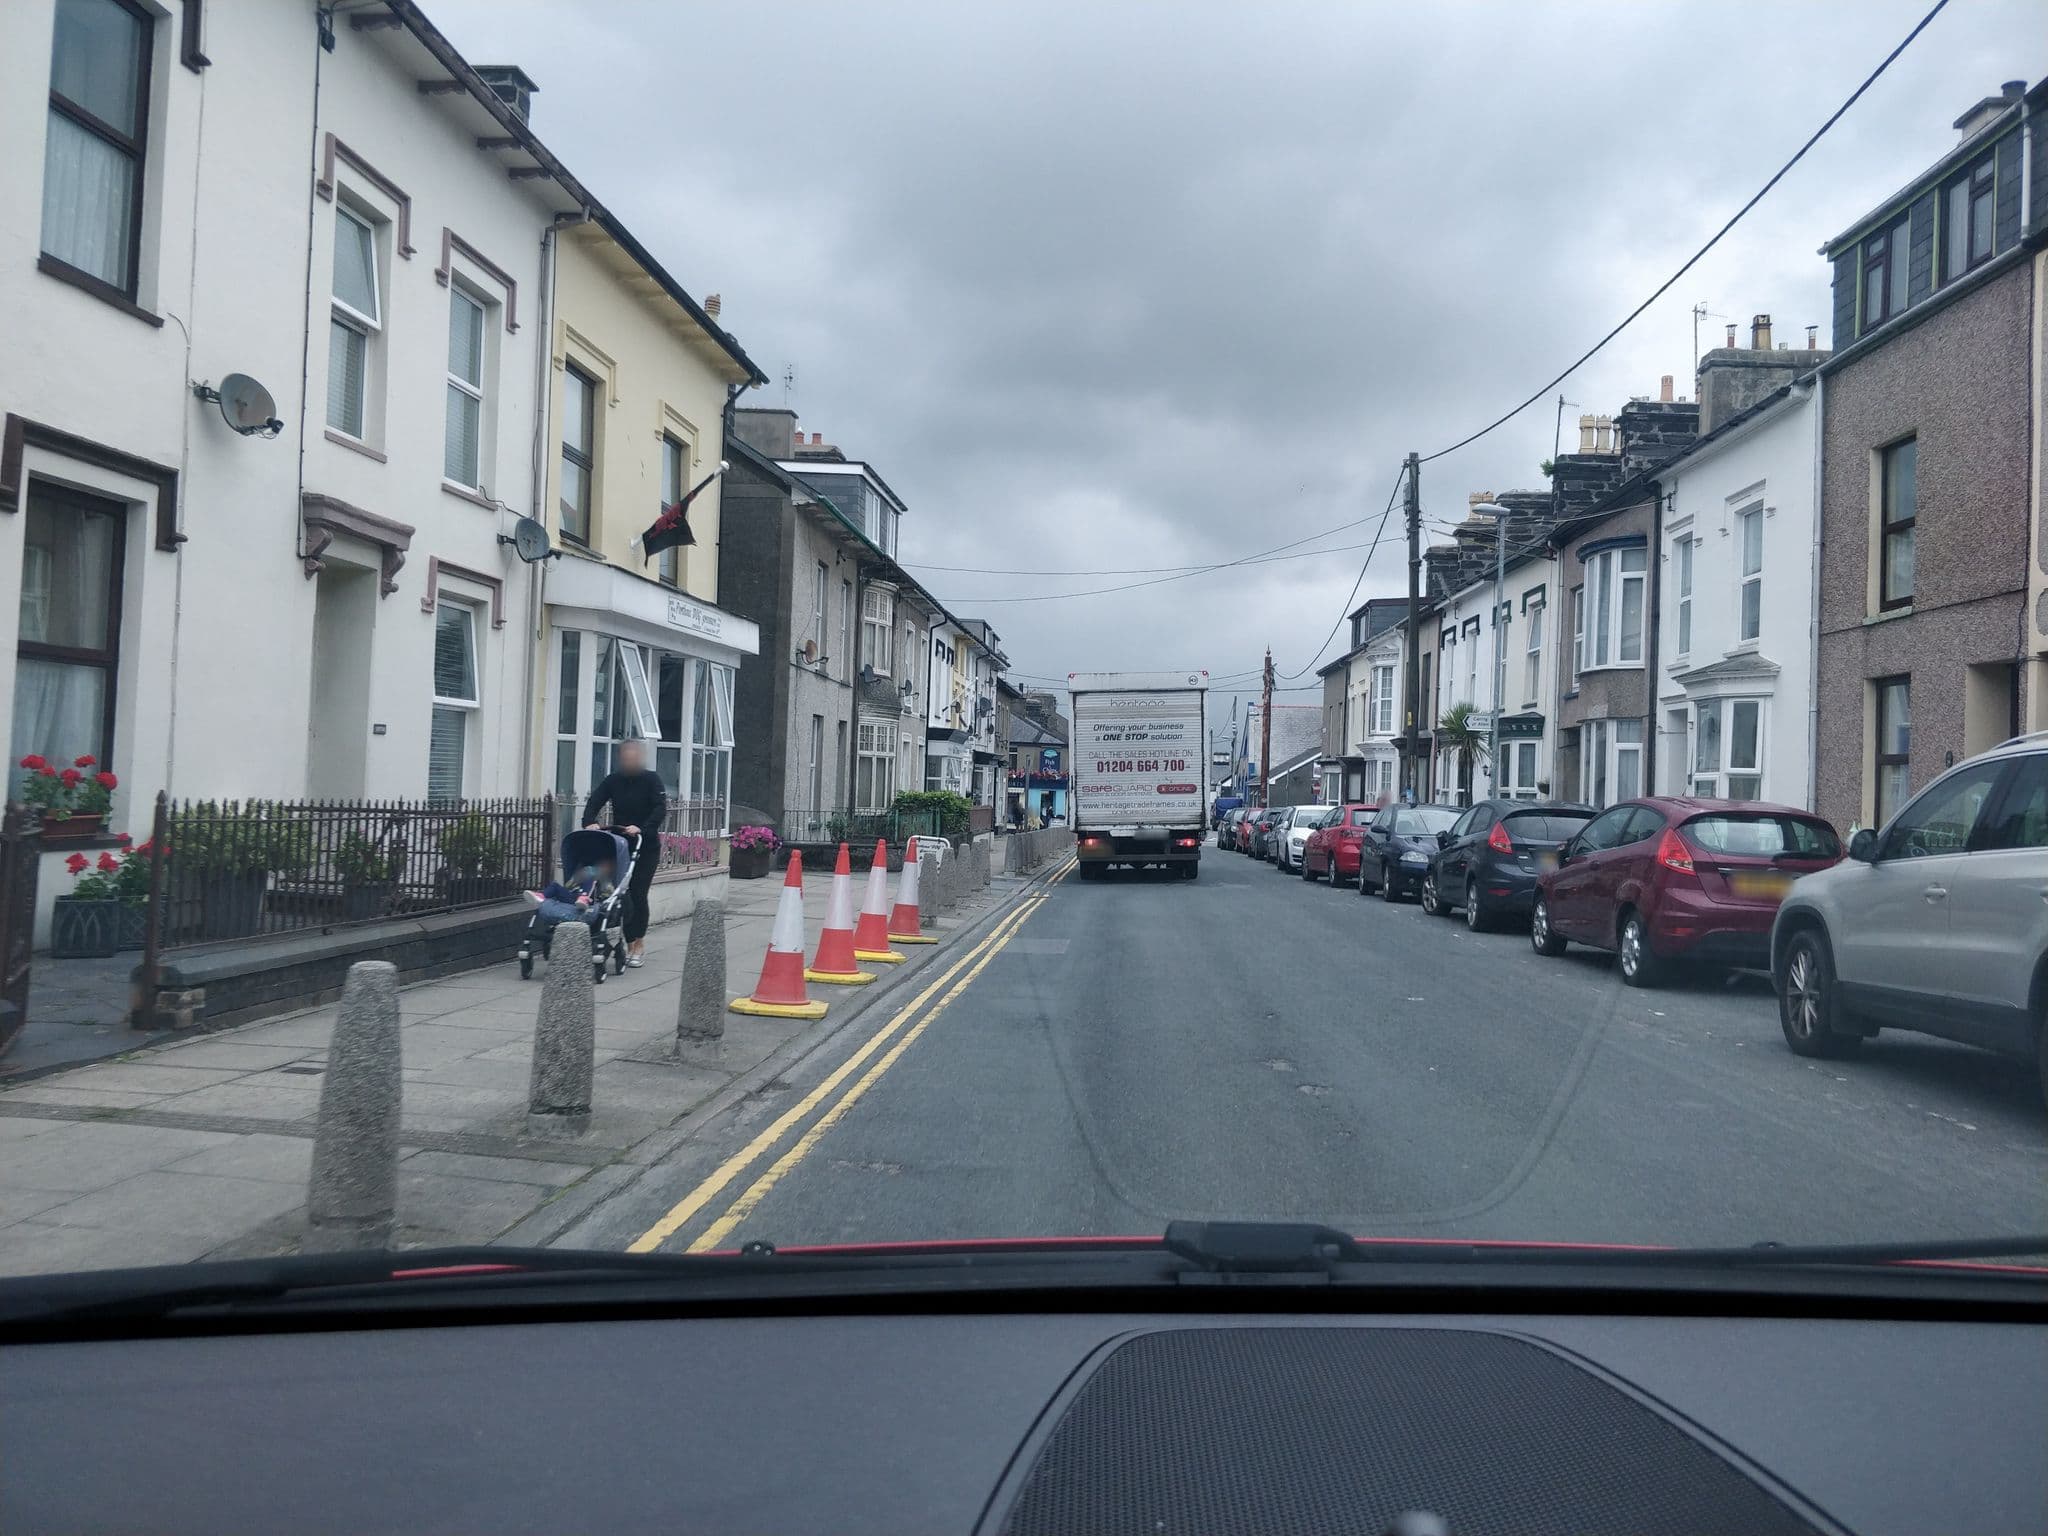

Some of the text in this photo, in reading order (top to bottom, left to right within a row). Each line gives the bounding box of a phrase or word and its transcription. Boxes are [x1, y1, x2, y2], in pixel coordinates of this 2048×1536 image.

[1093, 722, 1185, 733] Offering your business
[1103, 733, 1122, 741] ONE
[1125, 733, 1149, 741] STOP
[1150, 732, 1184, 741] solution
[1088, 749, 1194, 760] CALL THE SALES HOTLINE ON
[1097, 759, 1185, 773] 01204 664 700
[1082, 800, 1198, 810] www.heritagetradeframes.co.uk
